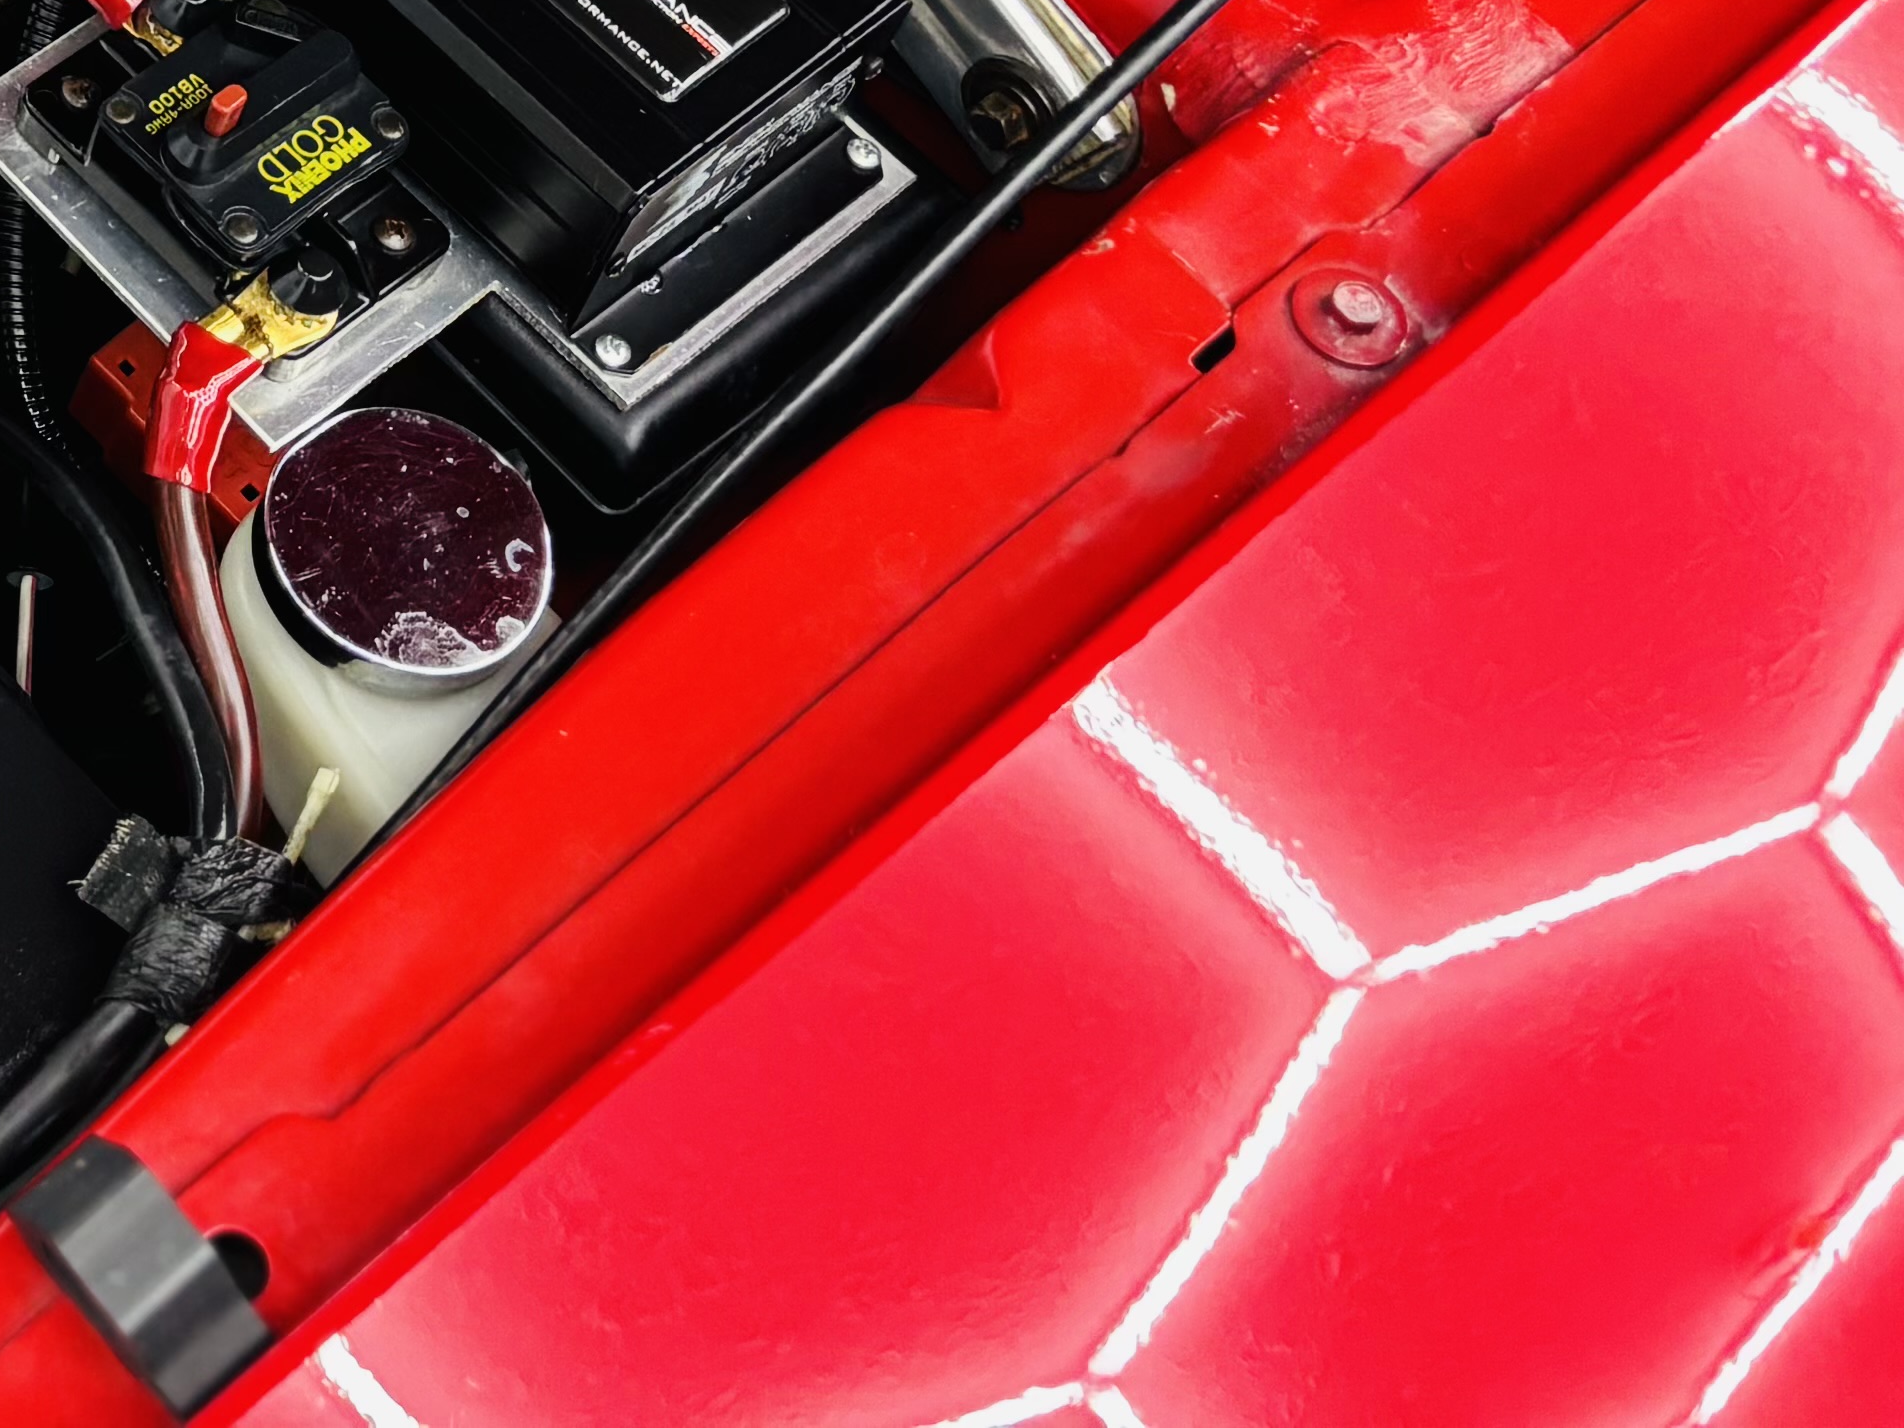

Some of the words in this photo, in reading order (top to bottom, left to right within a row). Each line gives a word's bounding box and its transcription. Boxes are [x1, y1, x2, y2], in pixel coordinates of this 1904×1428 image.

[146, 69, 204, 115] VB100
[251, 108, 349, 188] GOLD
[268, 126, 371, 204] PHOENIX
